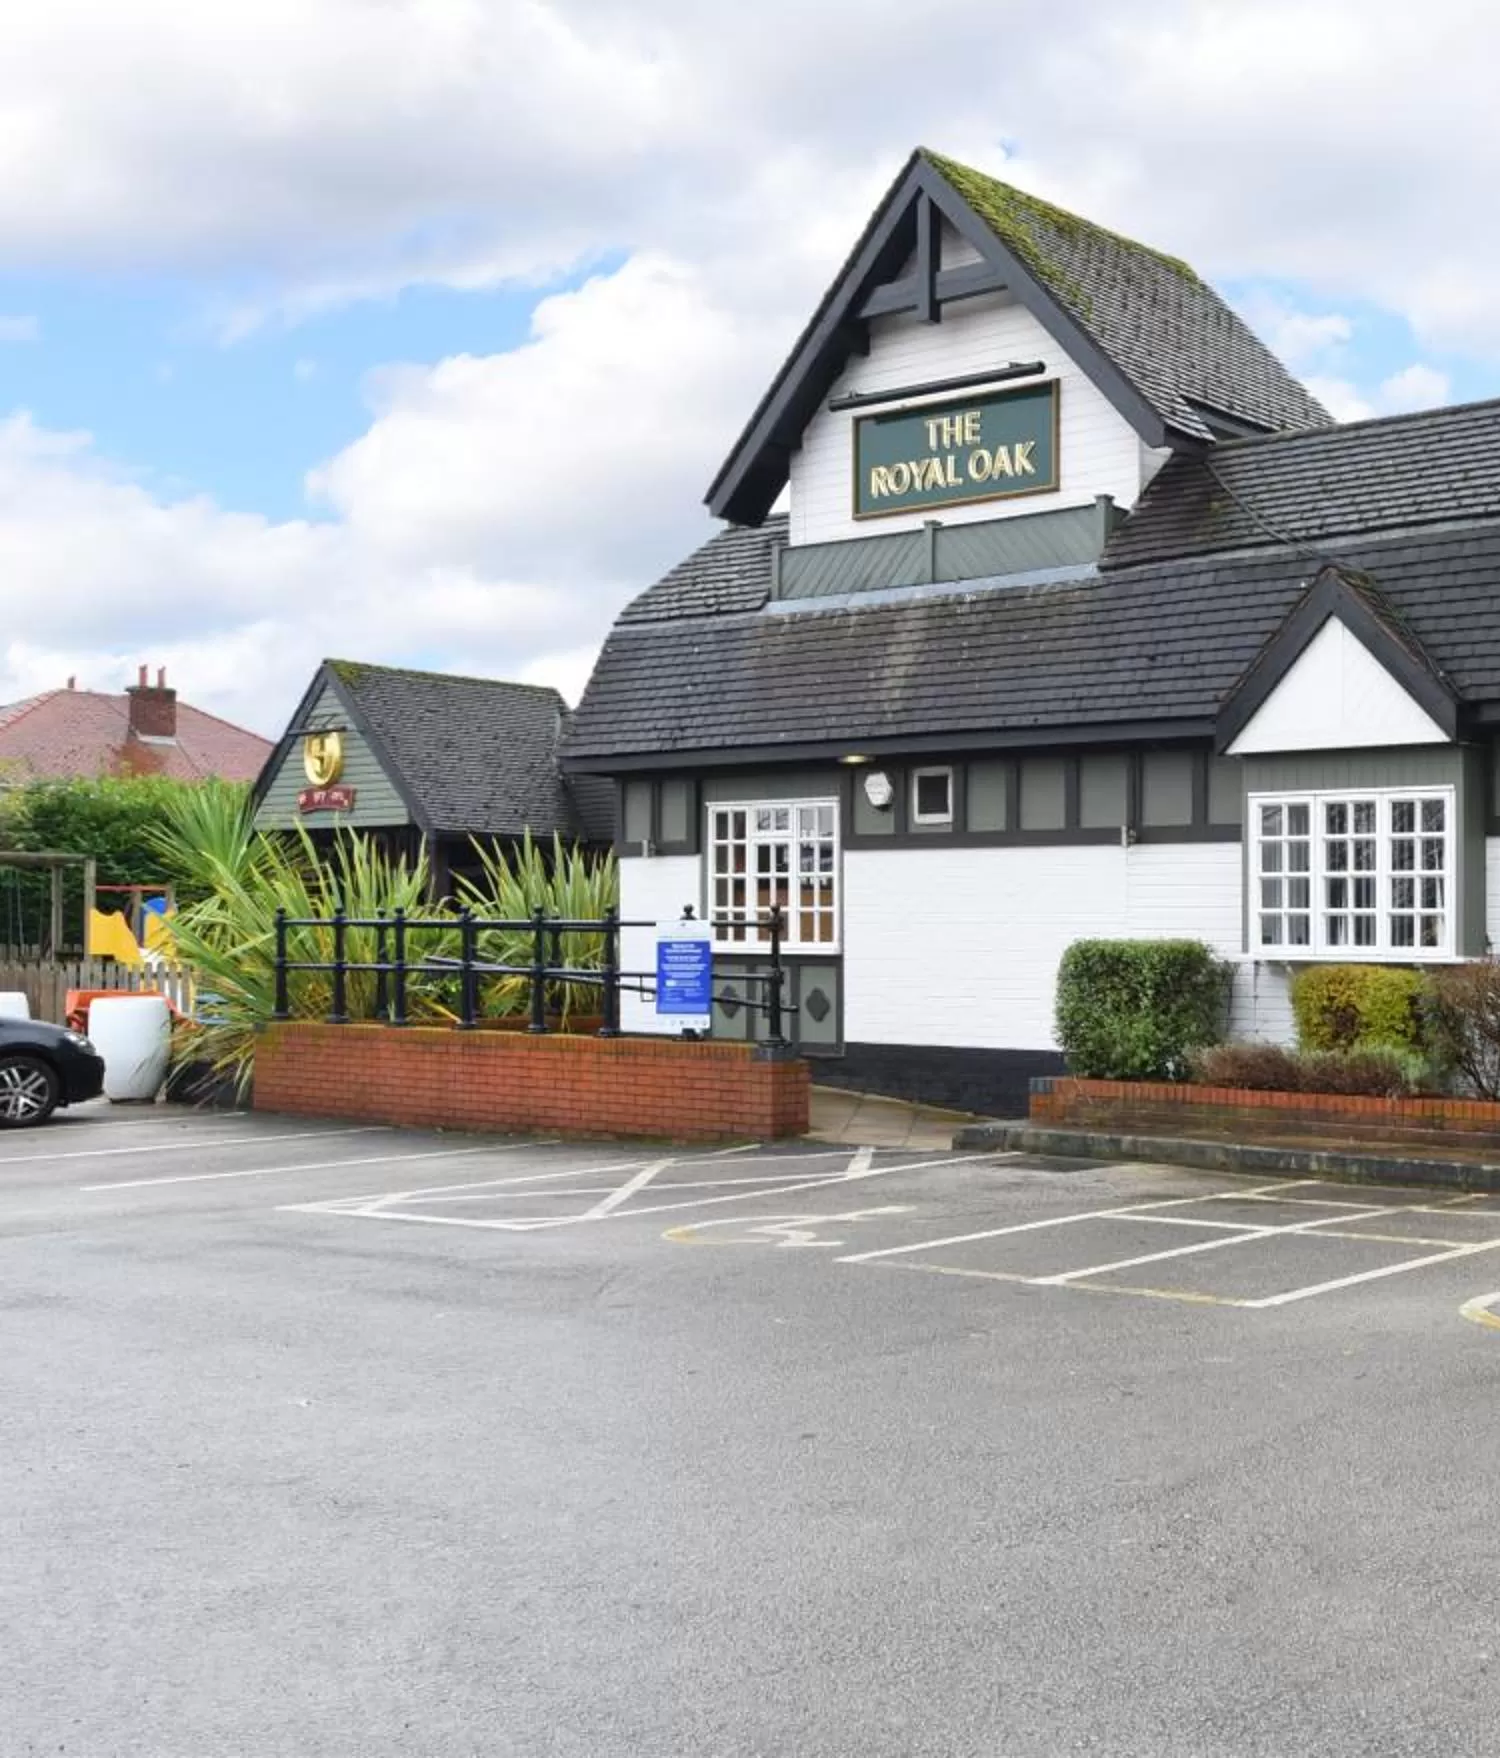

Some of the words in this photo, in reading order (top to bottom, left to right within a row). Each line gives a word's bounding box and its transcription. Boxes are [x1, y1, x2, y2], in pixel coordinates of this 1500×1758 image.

[925, 411, 982, 452] THE
[870, 455, 963, 499] ROYAL
[967, 440, 1036, 483] OAK
